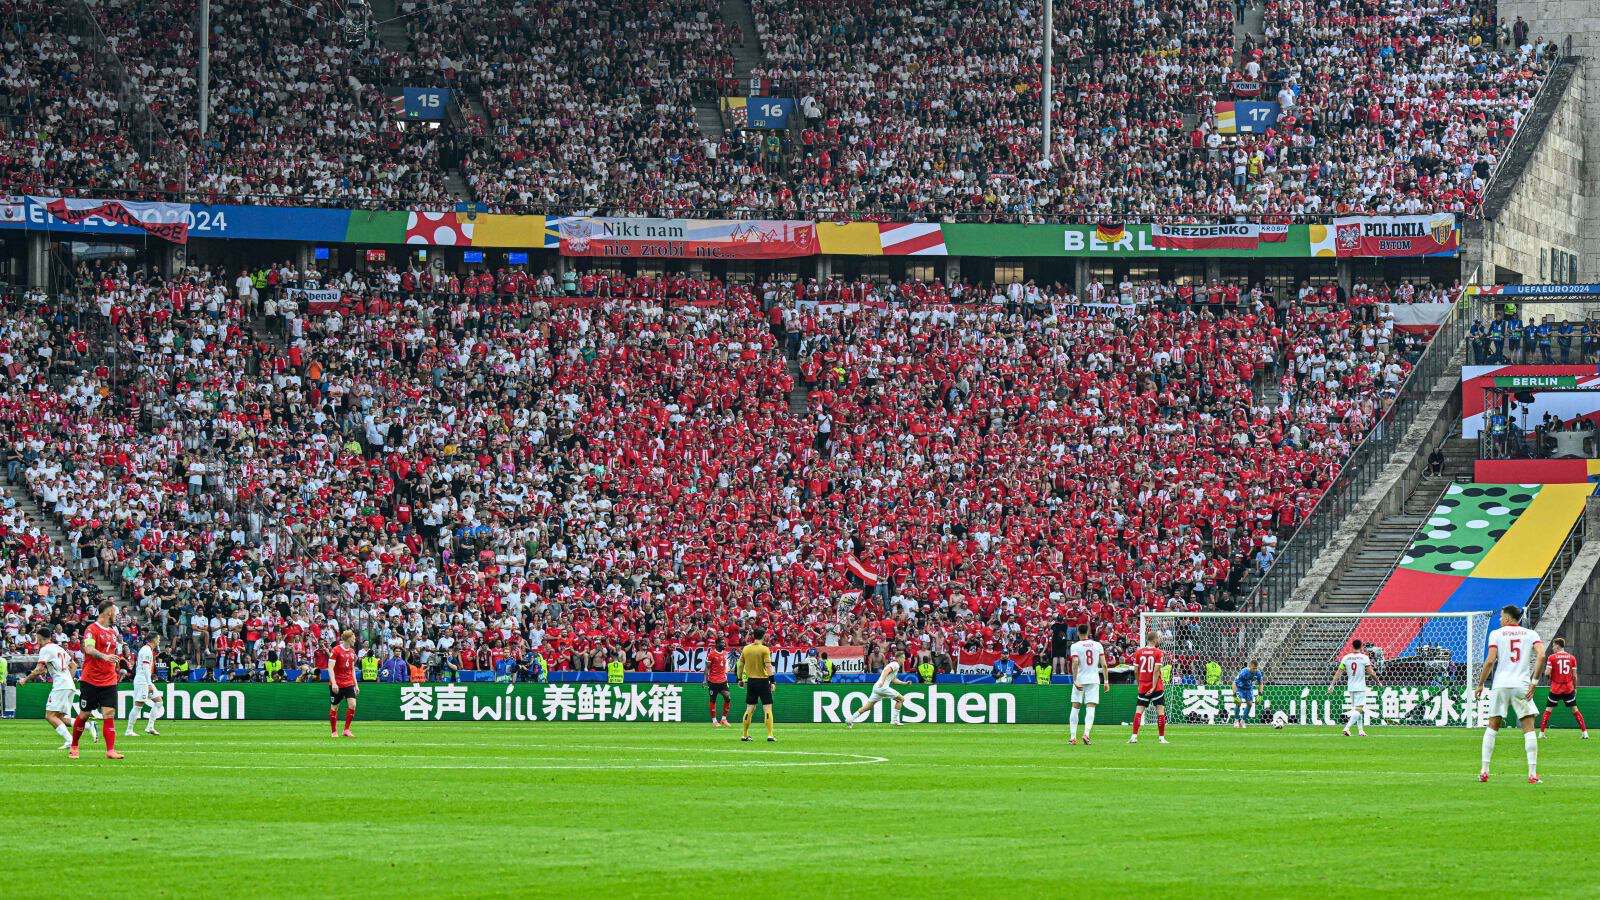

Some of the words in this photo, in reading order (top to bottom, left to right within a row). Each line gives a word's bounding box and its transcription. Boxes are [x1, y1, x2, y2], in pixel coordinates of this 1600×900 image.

[417, 94, 440, 108] 15
[760, 103, 783, 117] 16
[1248, 108, 1271, 121] 17
[603, 222, 640, 237] Nikt
[646, 224, 684, 238] nam
[1161, 225, 1250, 237] DREZDENKO
[1363, 222, 1426, 238] POLONIA
[603, 241, 632, 256] nie
[641, 241, 685, 257] zrobi
[1380, 240, 1412, 251] BYTOM
[1513, 377, 1558, 386] BERLIN
[105, 641, 112, 653] 7
[1510, 639, 1521, 663] 5
[1086, 650, 1094, 666] 8
[1140, 656, 1155, 673] 20
[1351, 661, 1358, 676] 9
[1557, 659, 1571, 675] 15
[400, 682, 468, 722] 容声
[473, 686, 538, 721] will
[542, 683, 683, 722] 养鲜冰箱
